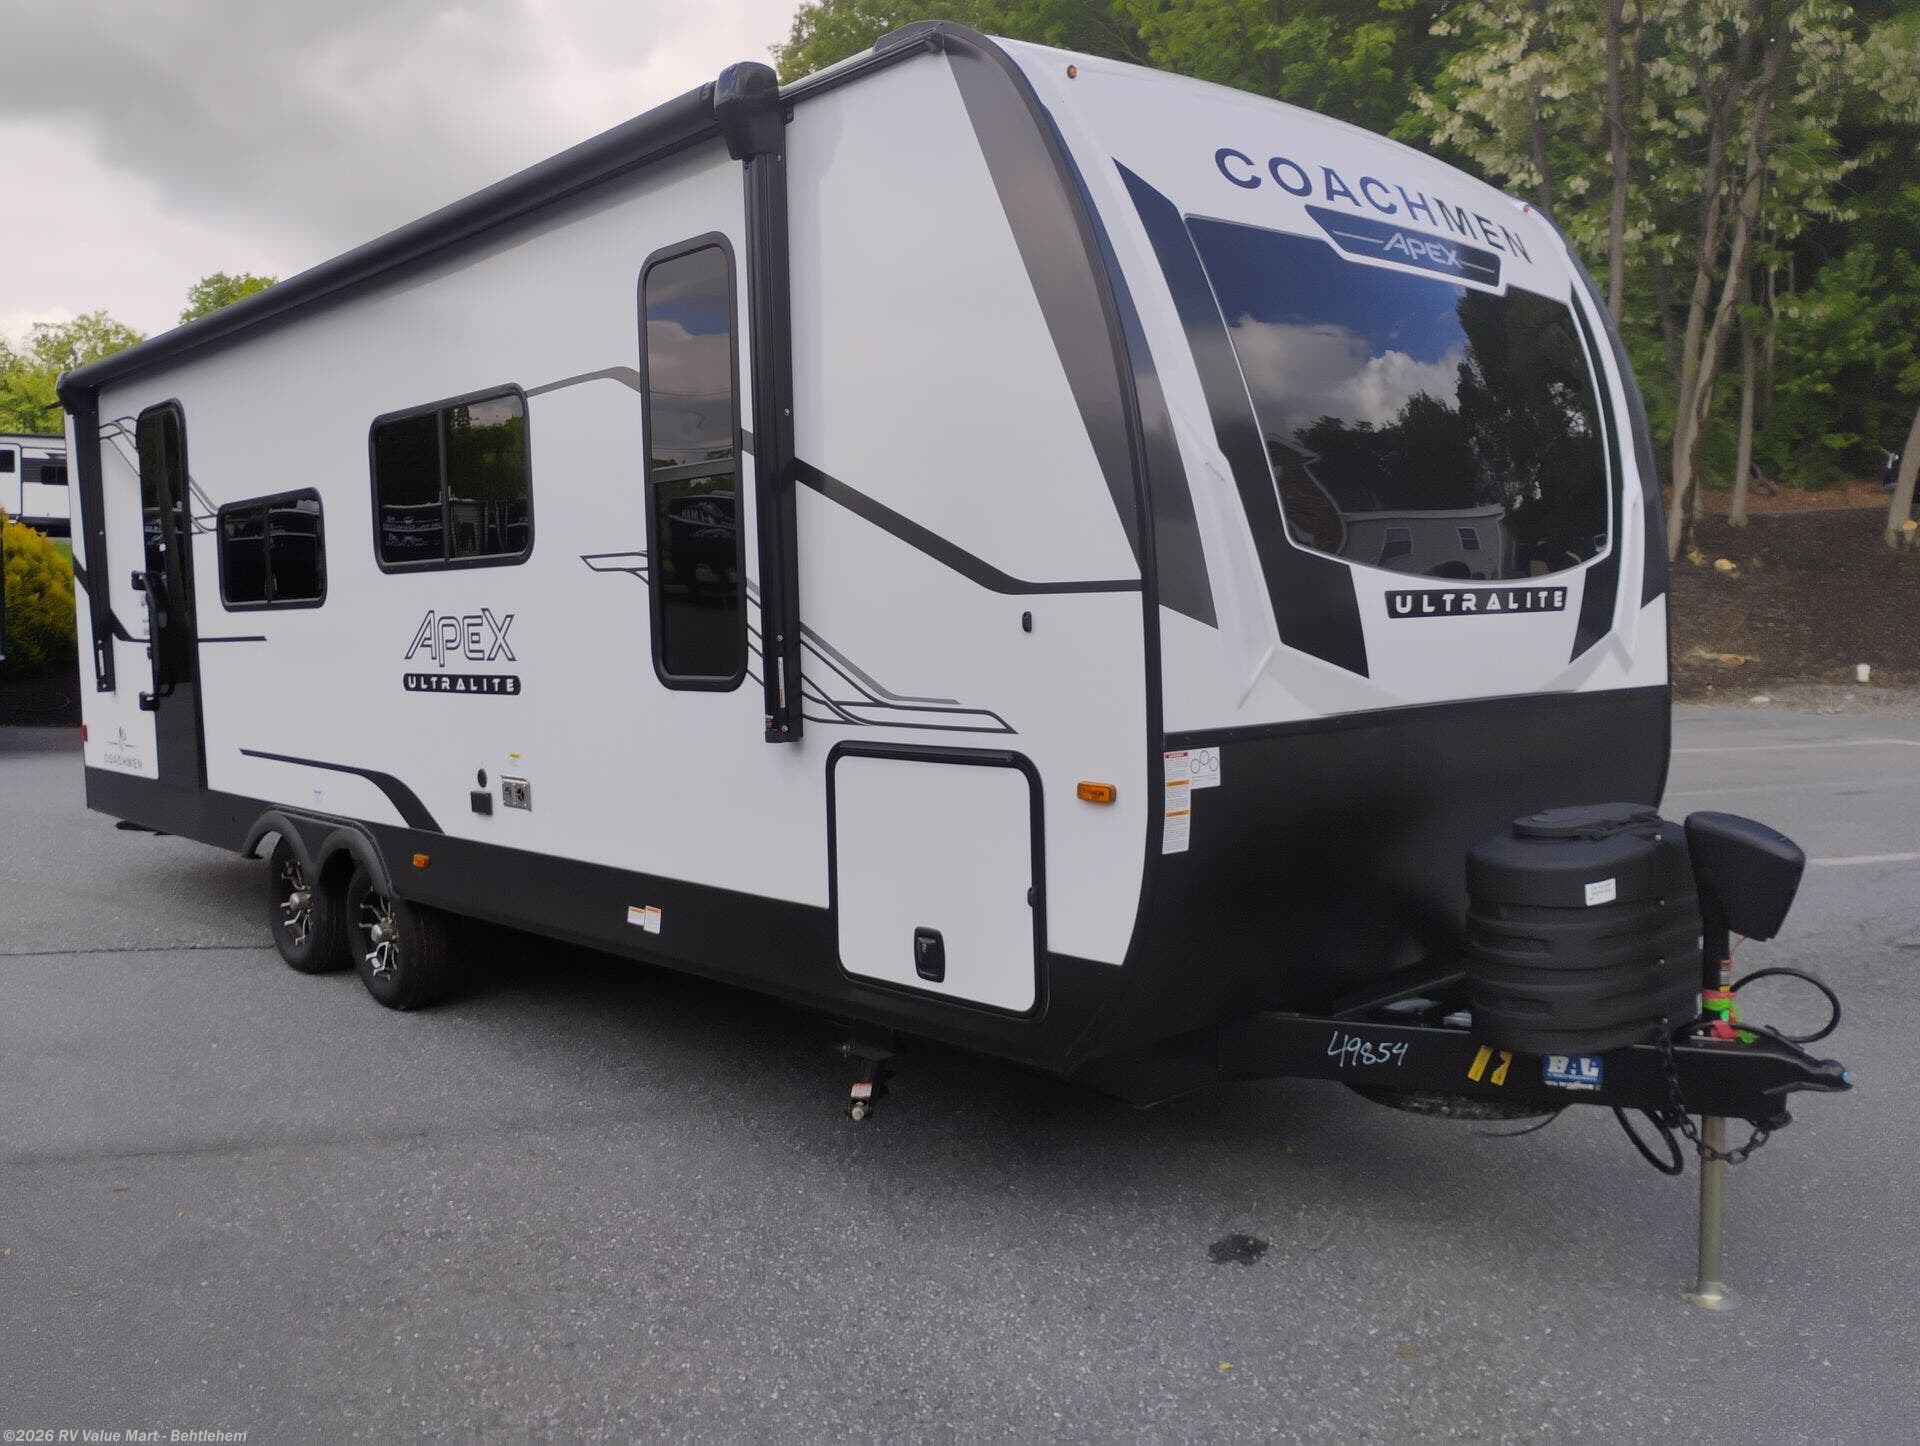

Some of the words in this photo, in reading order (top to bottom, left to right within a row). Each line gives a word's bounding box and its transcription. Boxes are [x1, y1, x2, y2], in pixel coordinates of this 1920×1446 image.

[1214, 147, 1534, 264] COACHMEN
[1383, 231, 1463, 270] APEX
[1395, 590, 1564, 614] ULTRALITE
[404, 607, 518, 668] APEX
[407, 675, 515, 693] ULTRALITE
